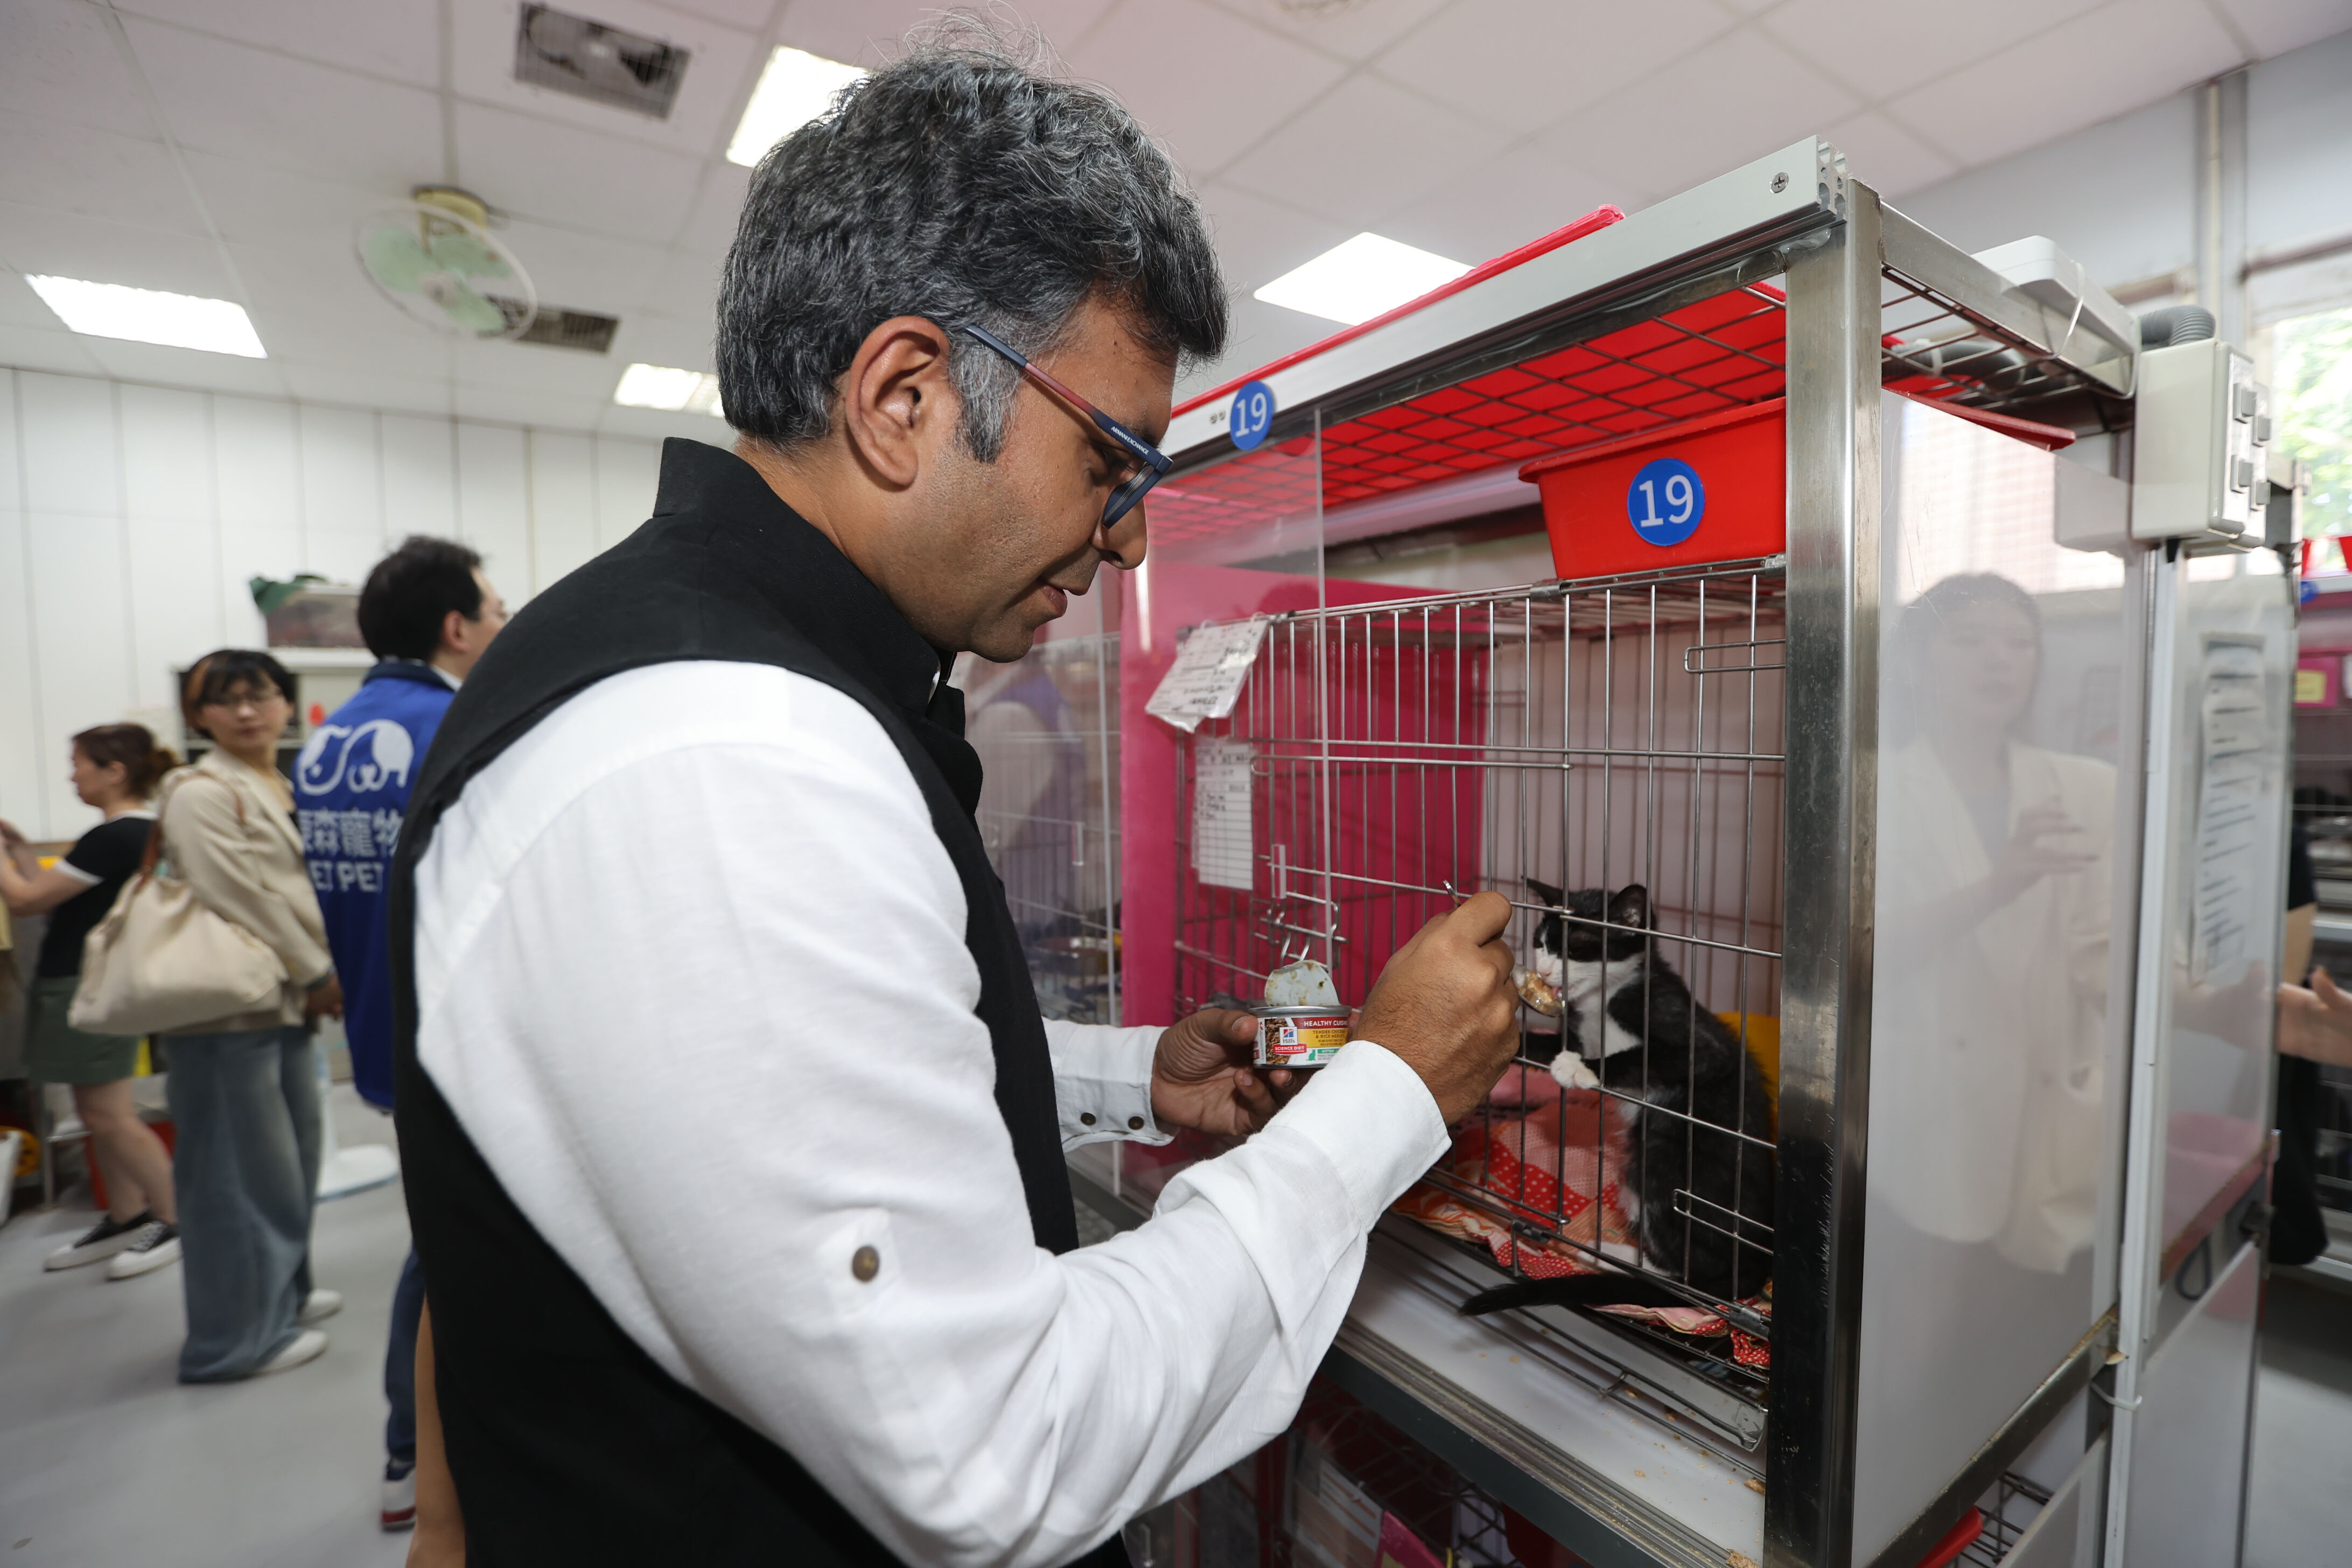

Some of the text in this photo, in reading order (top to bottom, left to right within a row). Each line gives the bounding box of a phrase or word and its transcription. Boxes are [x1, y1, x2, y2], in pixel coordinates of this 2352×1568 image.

[1235, 392, 1268, 437] 19
[1111, 426, 1150, 456] ARMANI EXCHANGE
[1639, 474, 1694, 528] 19
